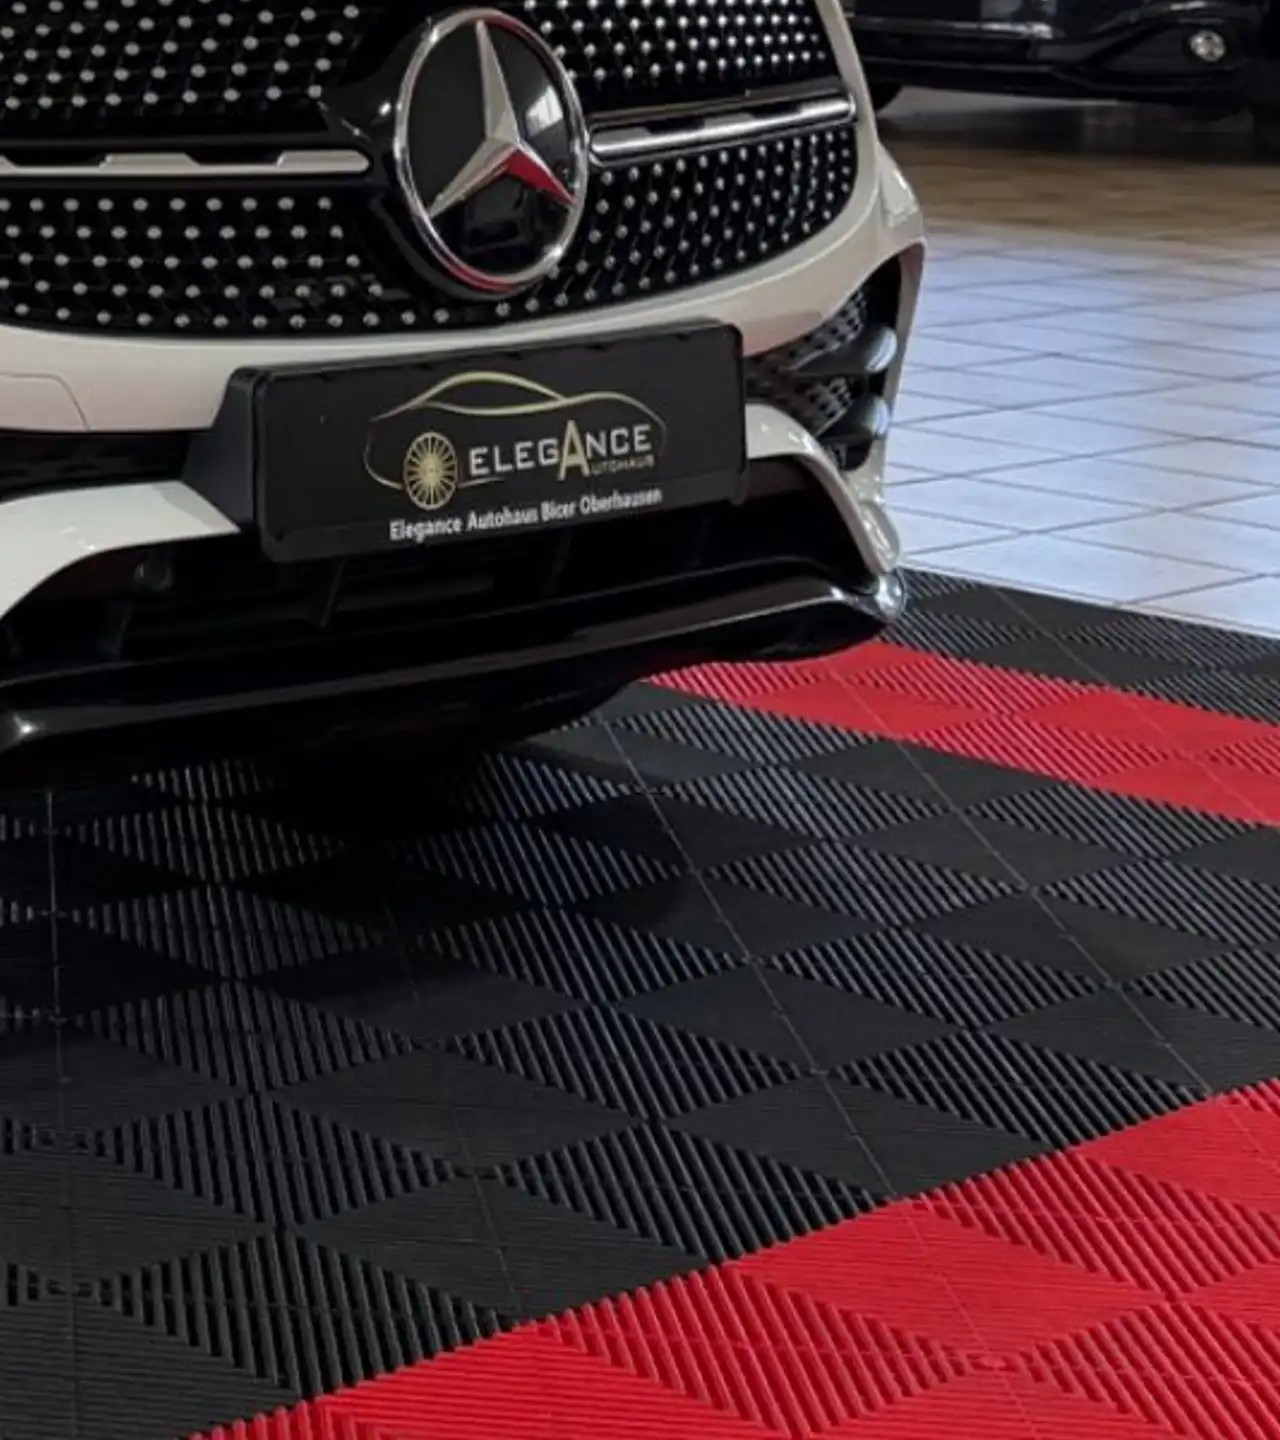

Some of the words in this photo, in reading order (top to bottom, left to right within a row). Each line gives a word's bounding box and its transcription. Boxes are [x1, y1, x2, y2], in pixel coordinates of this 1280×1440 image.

[469, 420, 653, 481] ELEGANCE
[390, 517, 462, 542] Elegance
[467, 508, 539, 531] Autohaus
[579, 488, 663, 514] Oberhausen
